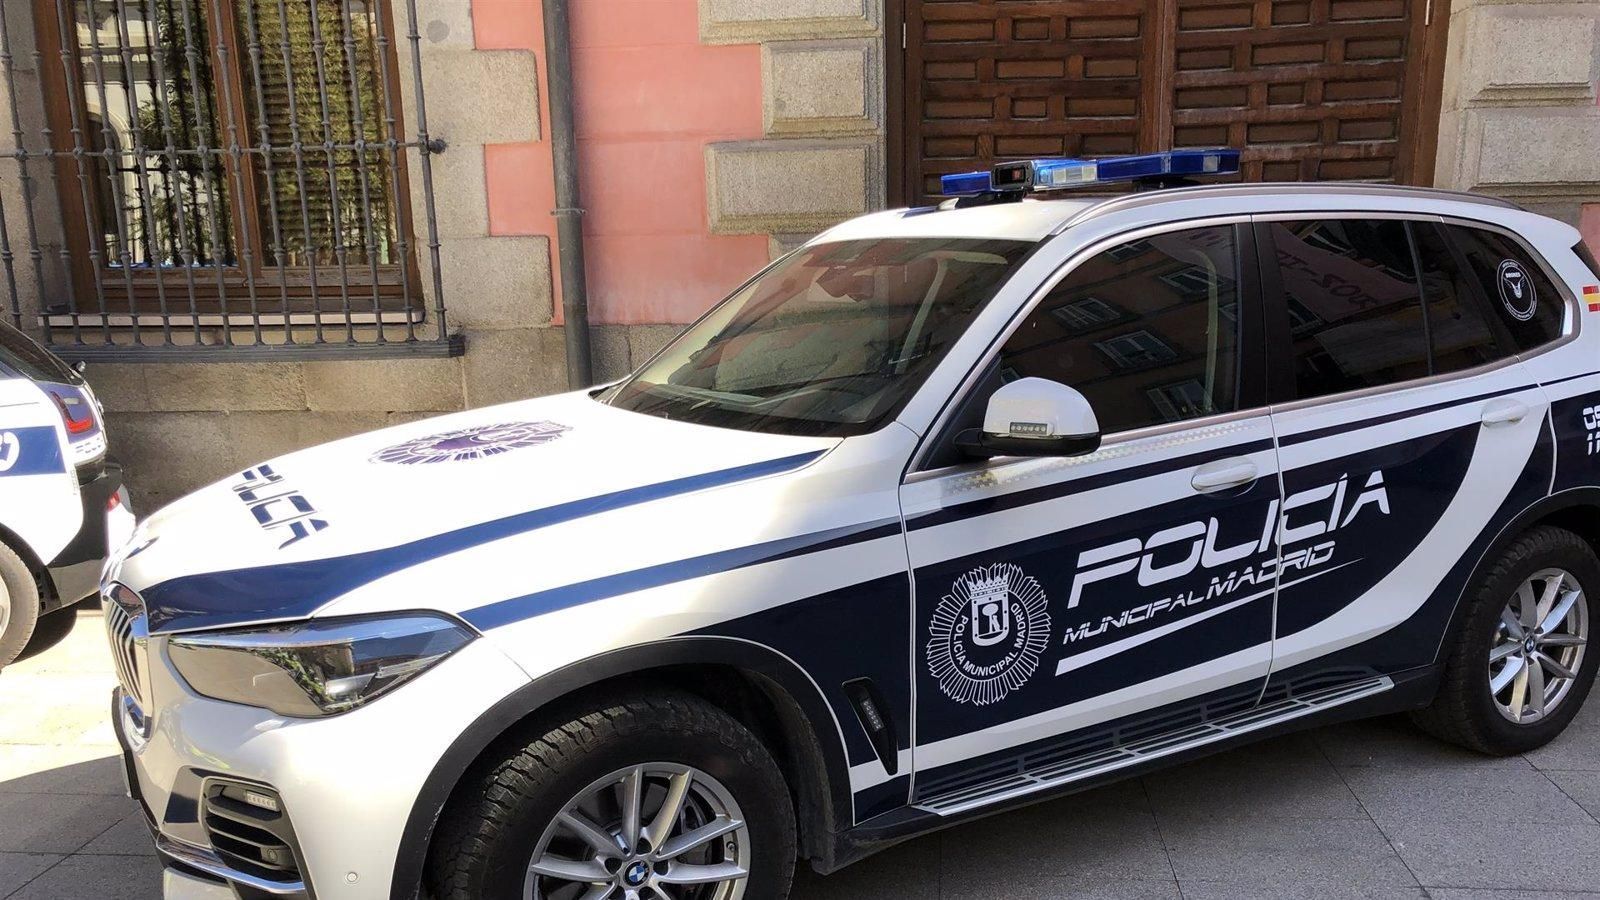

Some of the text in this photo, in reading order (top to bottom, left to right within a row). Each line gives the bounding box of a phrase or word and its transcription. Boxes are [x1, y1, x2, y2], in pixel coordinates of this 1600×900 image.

[1066, 470, 1391, 609] POLICÍA
[962, 650, 1019, 677] MUNICIPAL
[1010, 602, 1027, 649] MADRID
[1062, 540, 1336, 645] MUNICIPAL MADRID
